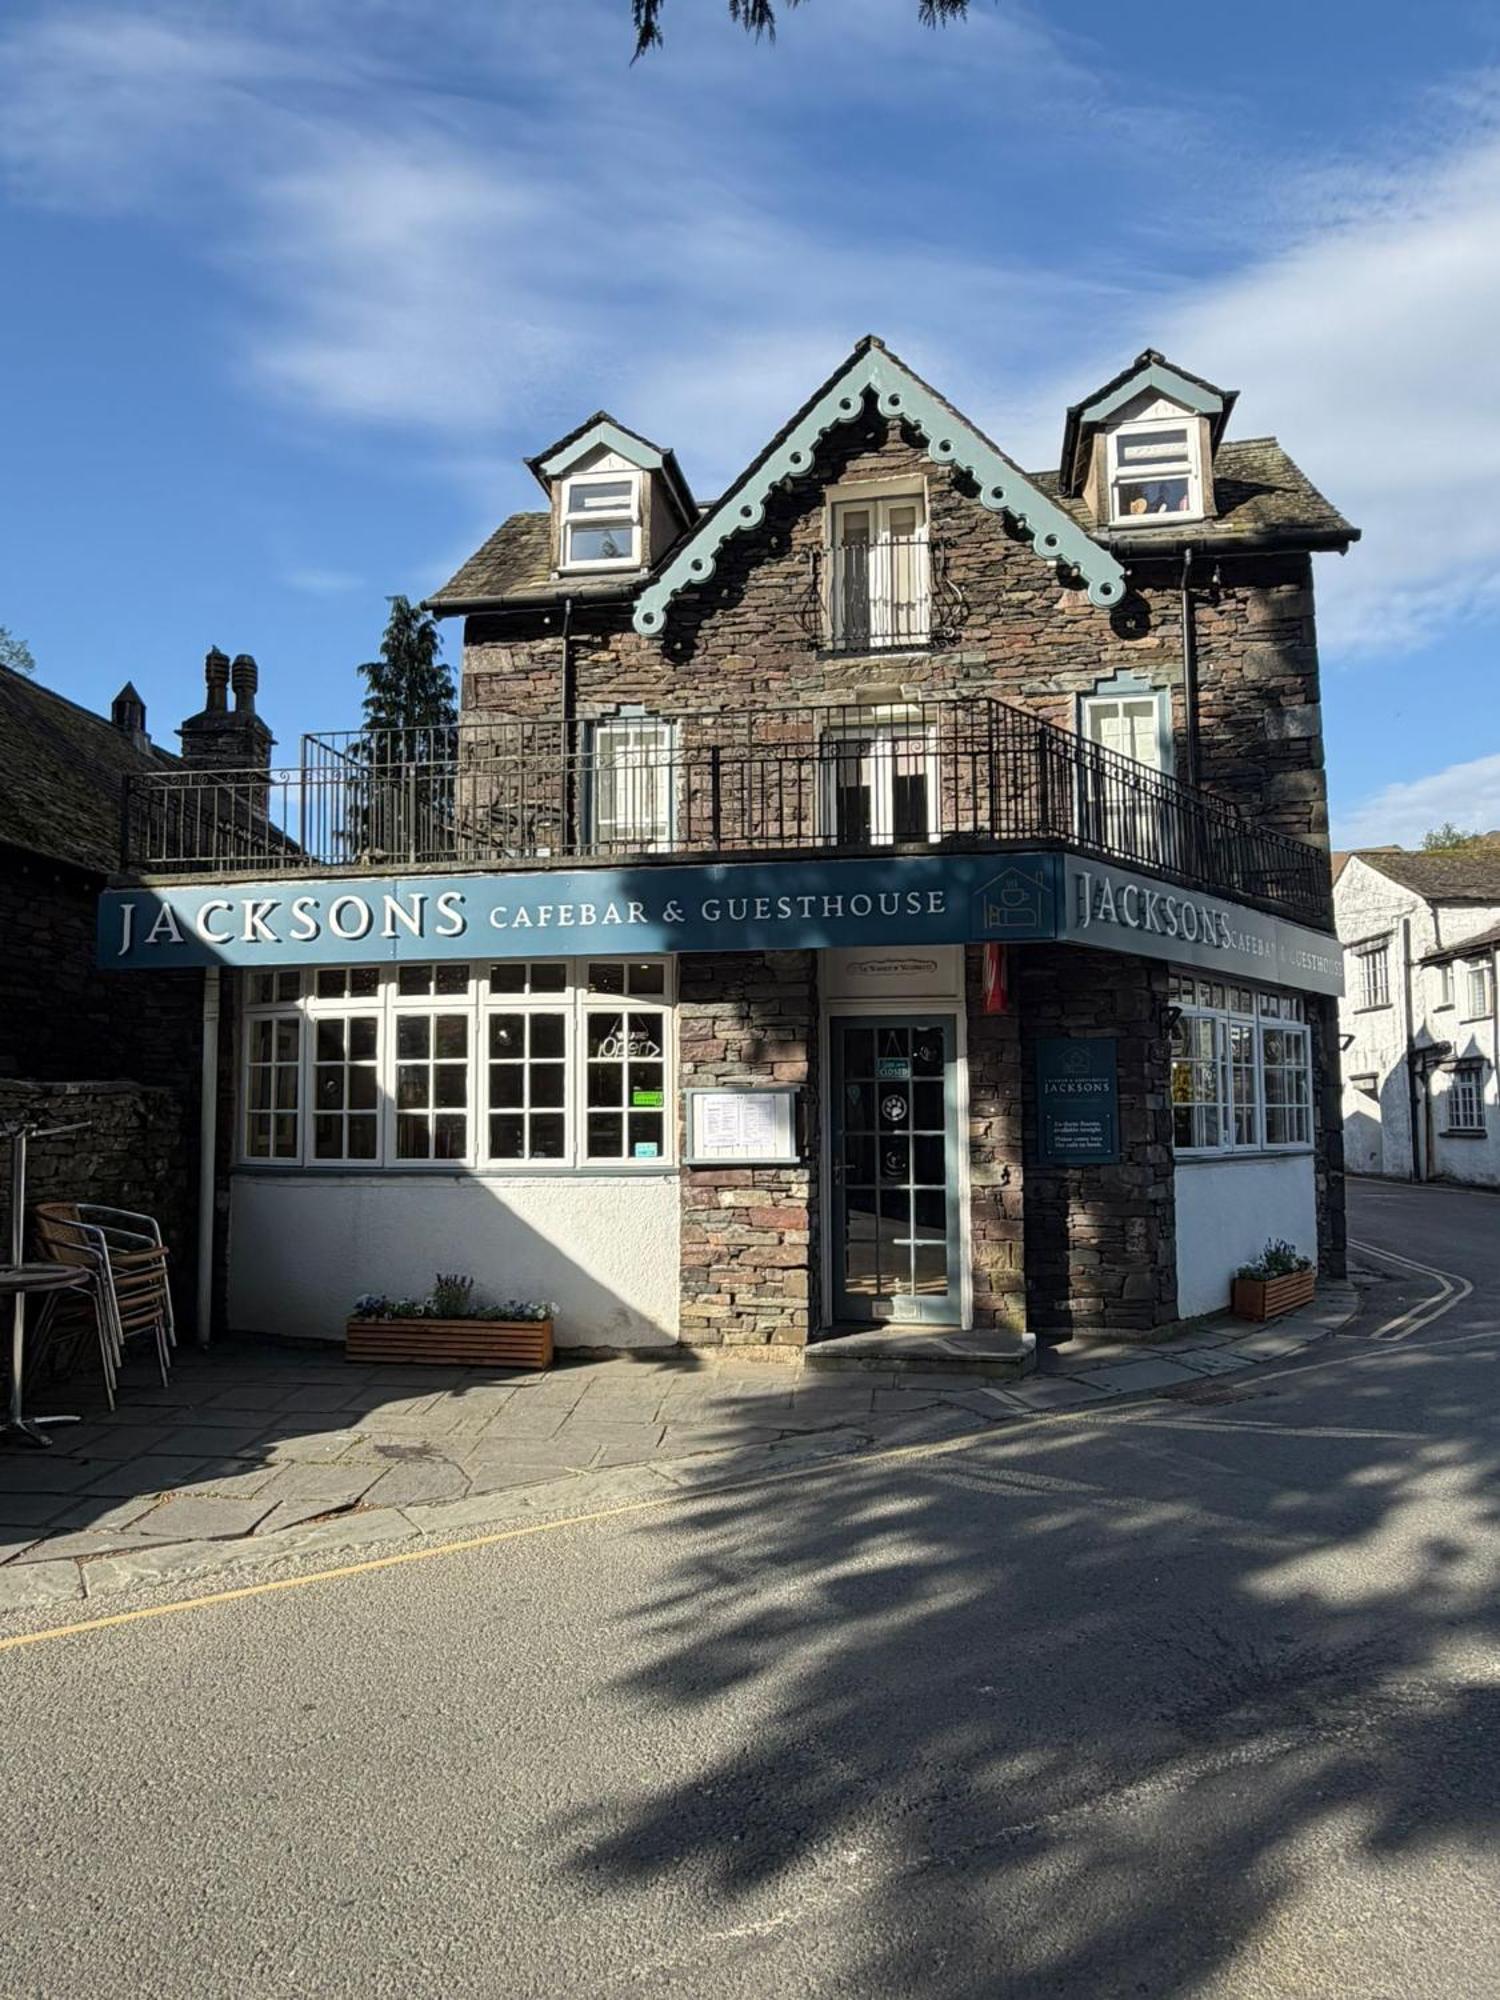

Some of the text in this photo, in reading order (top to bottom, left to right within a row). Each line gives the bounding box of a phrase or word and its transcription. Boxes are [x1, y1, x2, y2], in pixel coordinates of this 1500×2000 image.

[118, 890, 947, 956] JACKSONS CAFEBAR & GUESTHOUSE
[1081, 871, 1232, 949] JACKSONS
[1044, 1082, 1110, 1095] JACKSONS
